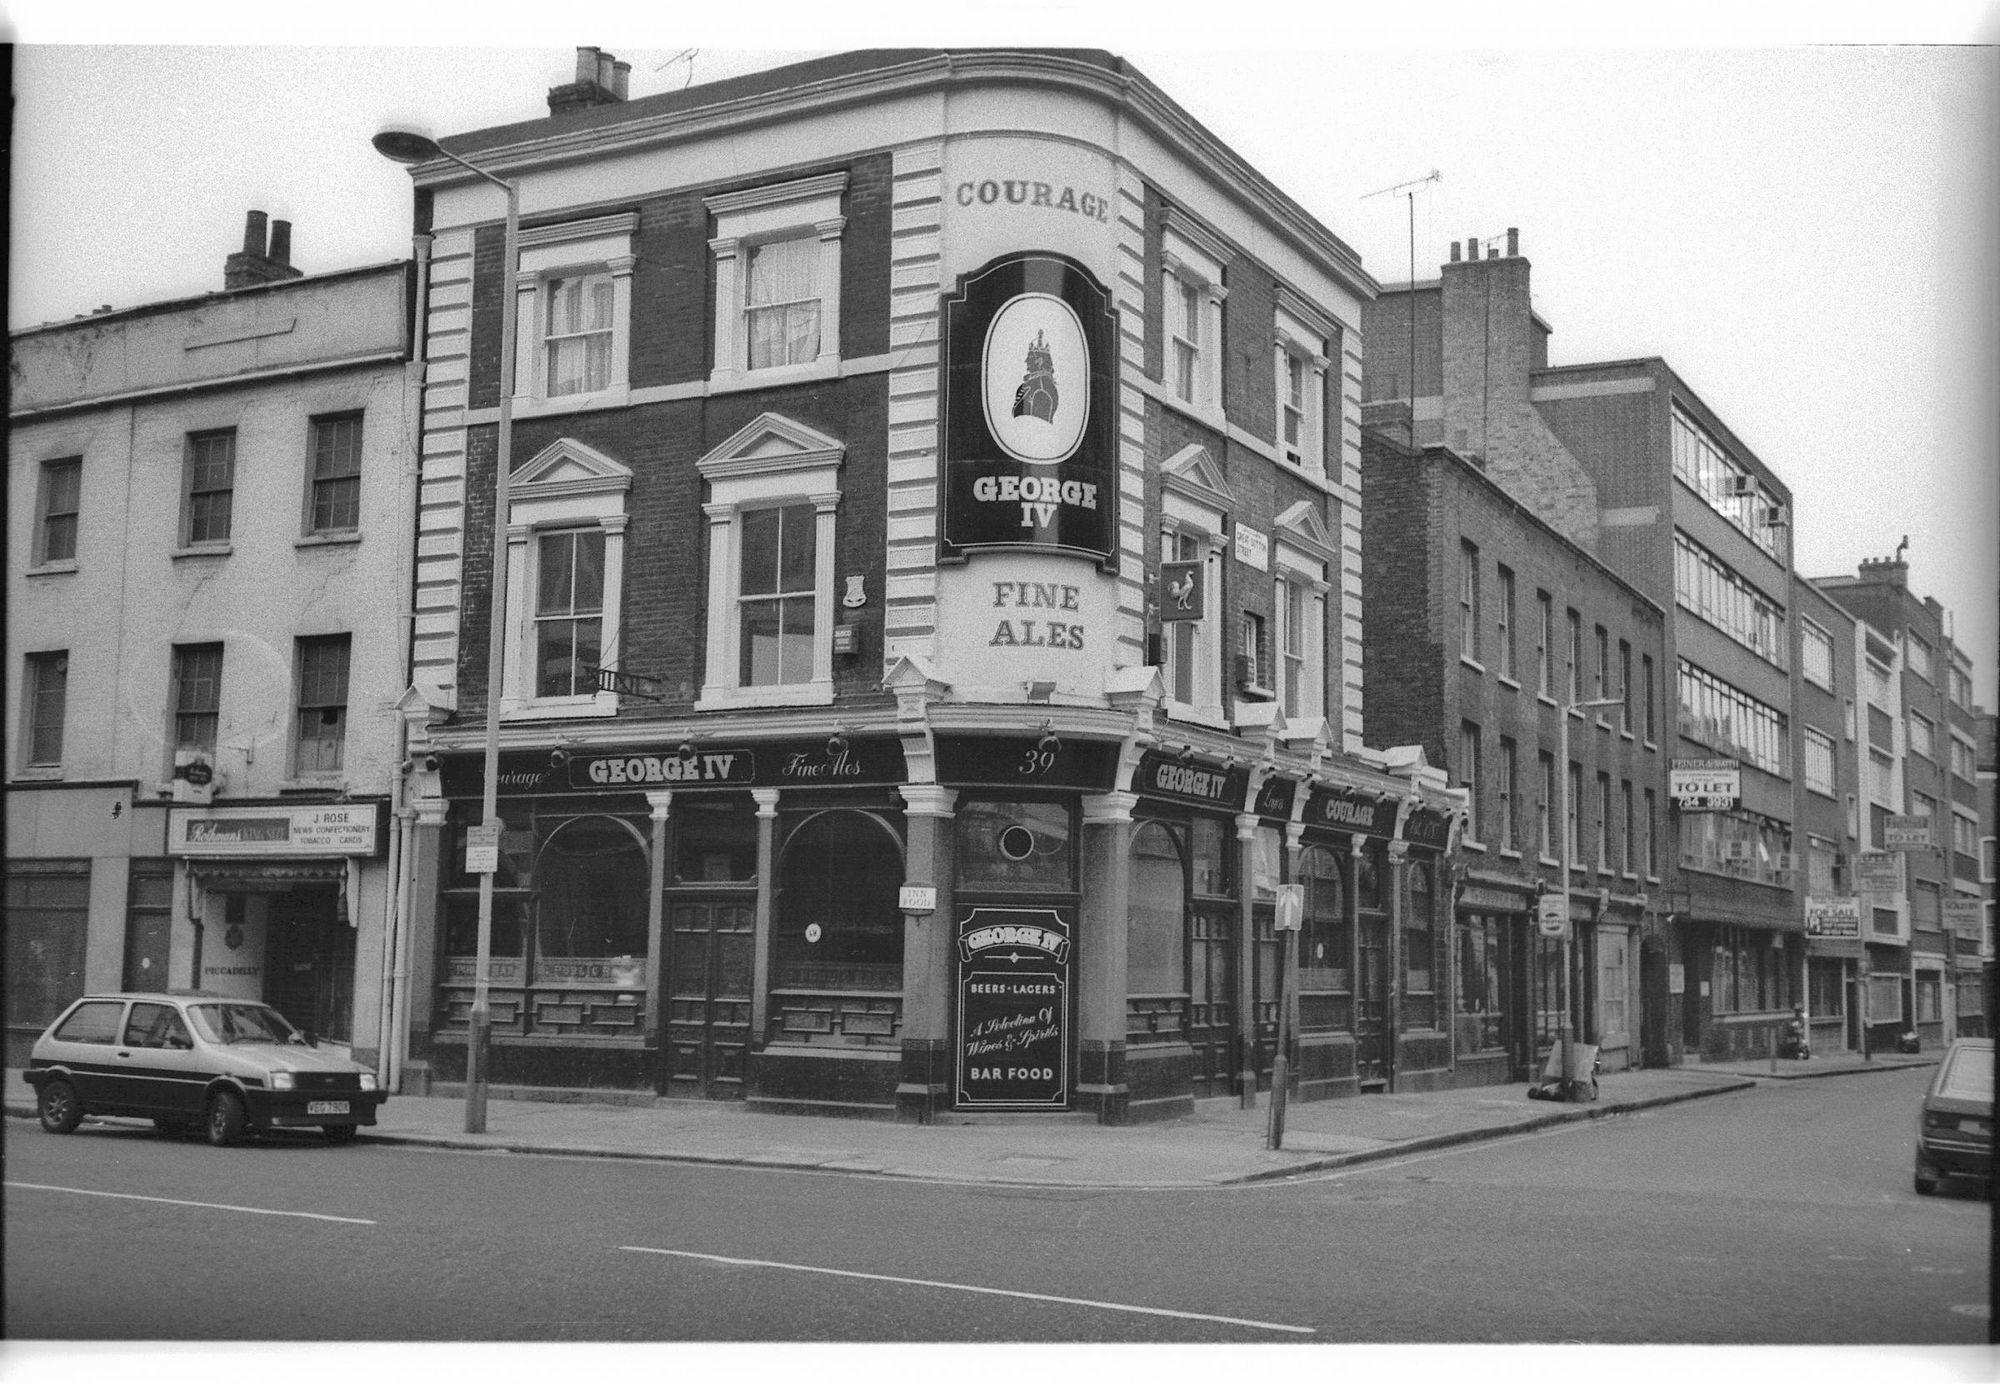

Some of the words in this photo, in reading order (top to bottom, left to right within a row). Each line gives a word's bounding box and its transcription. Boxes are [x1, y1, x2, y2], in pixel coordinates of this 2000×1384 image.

[956, 180, 1109, 224] COURAGE
[973, 476, 1097, 509] GEORGE
[1020, 503, 1058, 528] IV
[991, 581, 1080, 612] FINE
[988, 619, 1085, 651] ALES
[589, 755, 700, 784] GEORGE
[703, 754, 735, 780] IV
[782, 752, 820, 777] Fine
[1018, 750, 1055, 776] 39
[1156, 764, 1209, 796] GEORGE
[1208, 774, 1227, 799] IV
[1674, 783, 1699, 793] TO
[1704, 783, 1734, 793] LET
[323, 813, 349, 824] ROSE
[1325, 798, 1375, 827] COURAGE
[190, 821, 241, 841] Rothmans
[299, 837, 331, 845] TOBACCO
[316, 825, 370, 834] CONFECTIONERY
[903, 898, 932, 907] FOOD
[907, 889, 928, 898] INN
[968, 926, 1043, 950] GEORGE
[1042, 932, 1064, 952] IV
[204, 966, 259, 976] PICCADILLY
[971, 983, 1006, 994] BEERS
[1013, 983, 1056, 995] LAGERS
[970, 1022, 983, 1038] A
[985, 1011, 1036, 1035] Selection
[1039, 1005, 1053, 1025] Of
[966, 1038, 1003, 1057] Wines
[1017, 1023, 1059, 1049] Spirits
[970, 1067, 1002, 1080] BAR
[1008, 1067, 1053, 1080] FOOD
